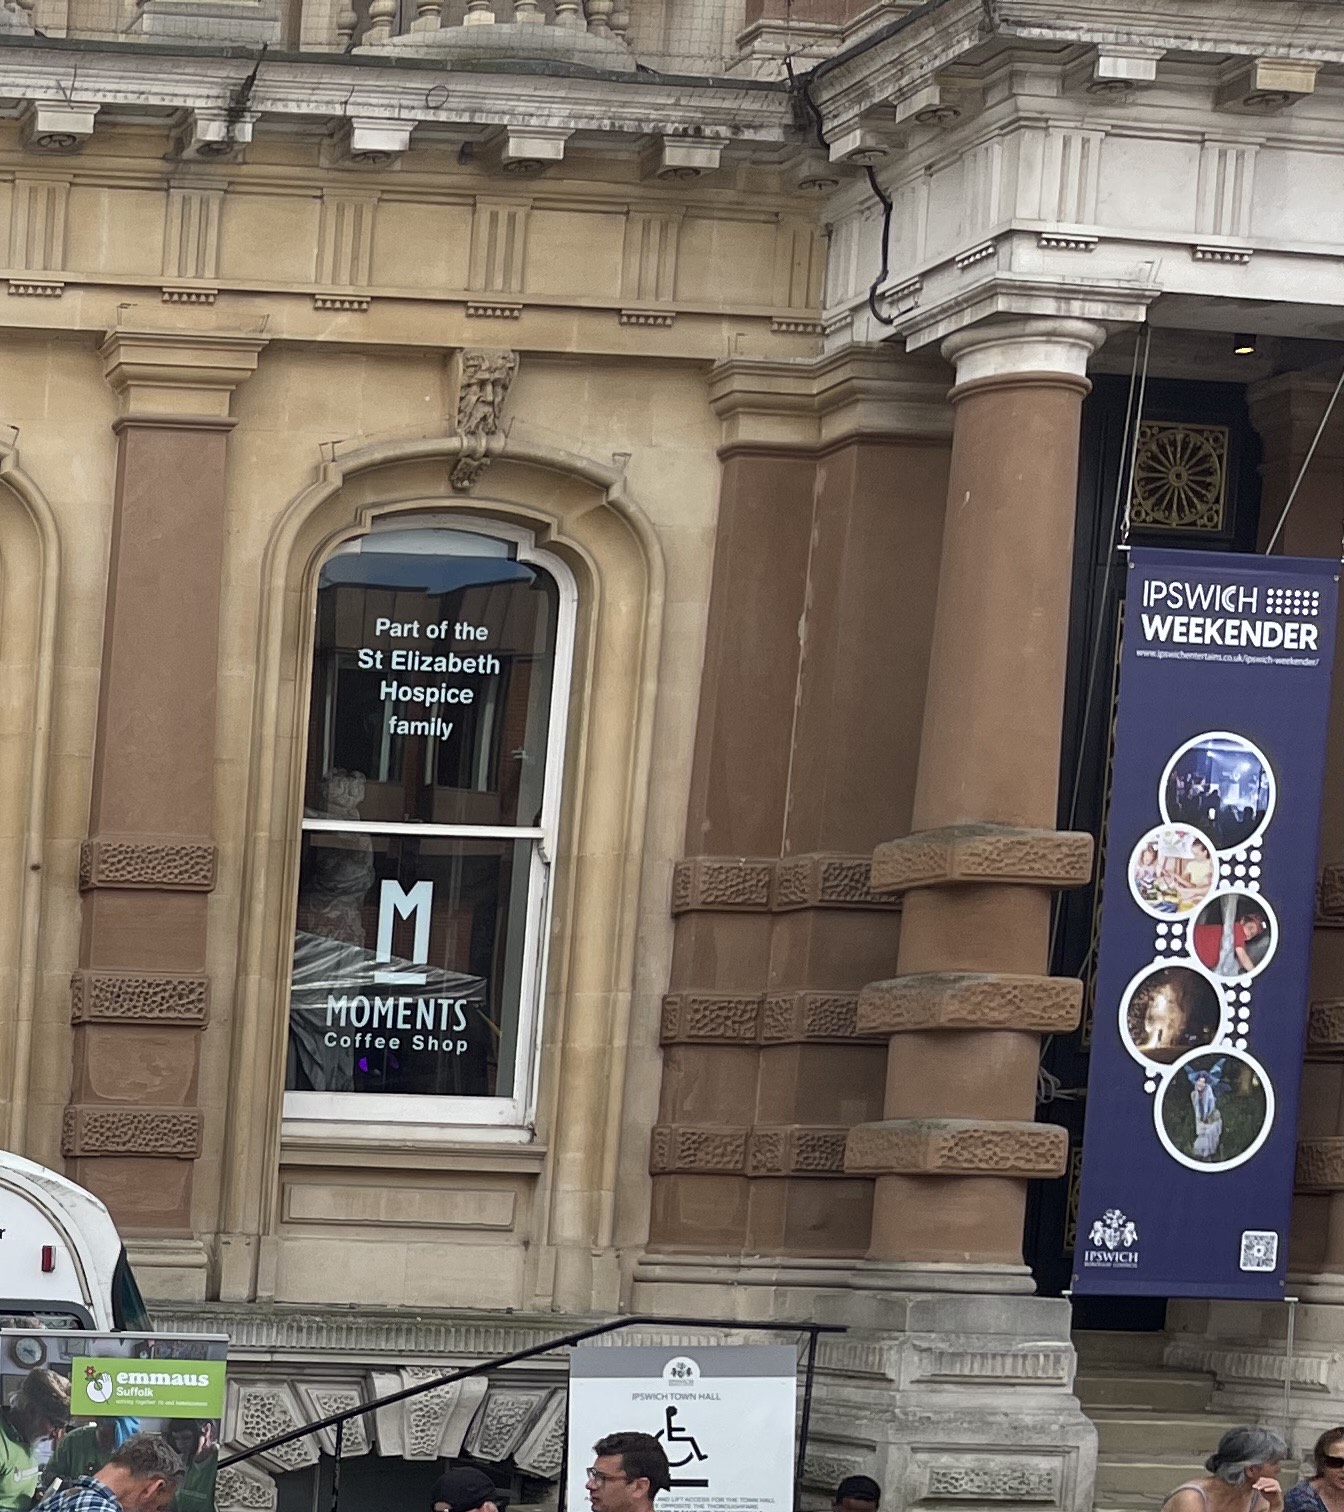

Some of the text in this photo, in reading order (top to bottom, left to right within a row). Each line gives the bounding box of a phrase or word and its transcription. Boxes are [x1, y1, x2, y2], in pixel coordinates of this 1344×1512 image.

[1143, 580, 1258, 614] IPSWICH
[376, 618, 489, 641] Part of the
[1141, 614, 1318, 650] WEEKENDER
[358, 649, 500, 675] St Elizabeth
[380, 681, 474, 710] Hospice
[389, 716, 453, 741] family
[326, 995, 468, 1032] MOMENTS
[324, 1031, 469, 1054] Coffee Shop
[1085, 1251, 1138, 1263] IPSWICH
[116, 1371, 209, 1387] emmaus
[116, 1387, 154, 1397] Suffolk
[632, 1392, 721, 1401] IPSWICH TOWN HALL
